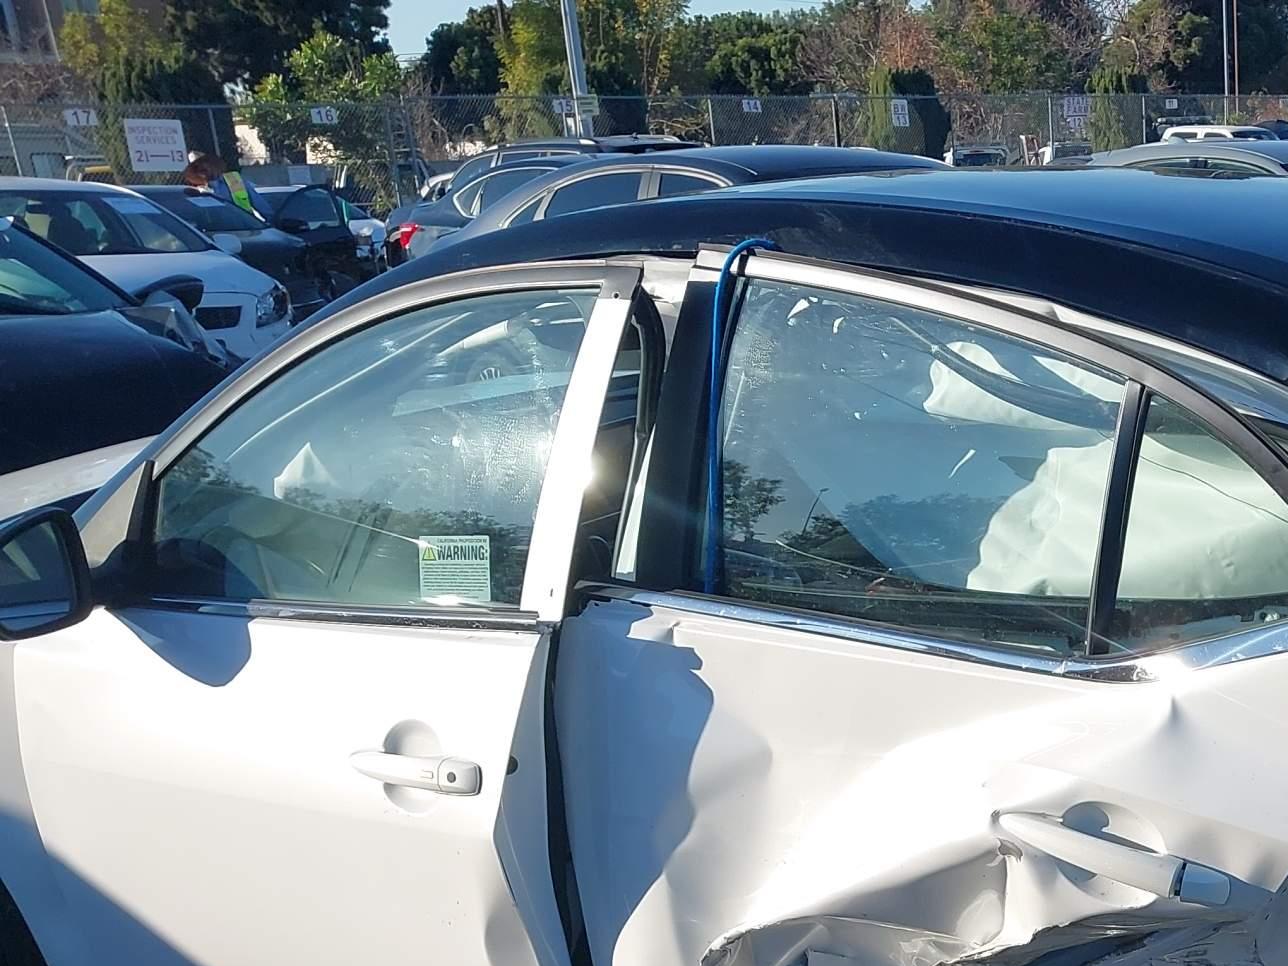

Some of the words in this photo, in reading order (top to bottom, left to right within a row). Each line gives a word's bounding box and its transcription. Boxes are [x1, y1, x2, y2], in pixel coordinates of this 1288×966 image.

[558, 100, 573, 113] 15
[746, 101, 759, 111] 14
[71, 110, 91, 125] 17
[315, 108, 334, 122] 16
[127, 127, 178, 135] INSPECTION
[135, 135, 177, 145] SERVICES
[437, 544, 489, 561] WARNING:
